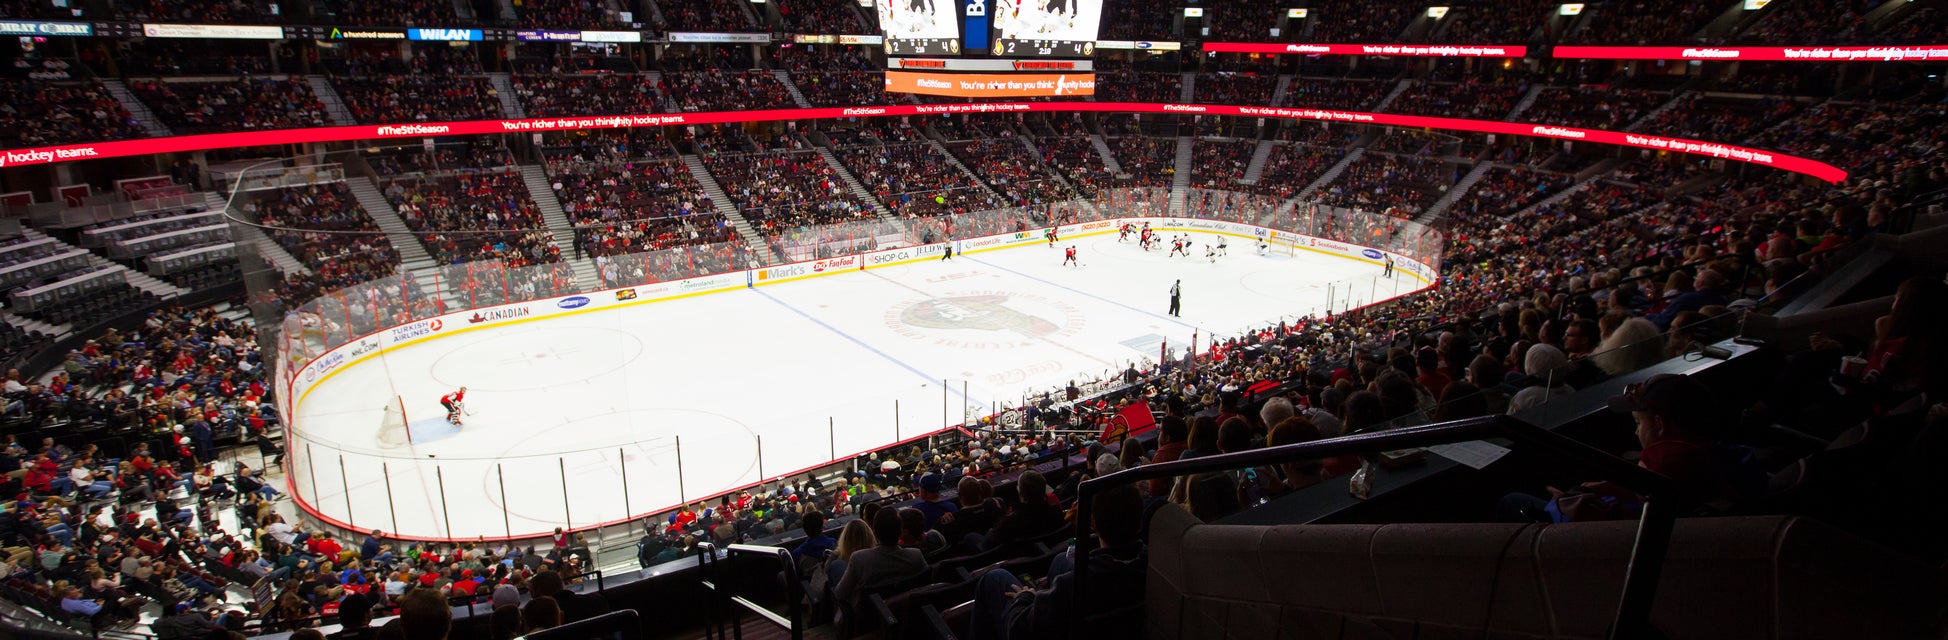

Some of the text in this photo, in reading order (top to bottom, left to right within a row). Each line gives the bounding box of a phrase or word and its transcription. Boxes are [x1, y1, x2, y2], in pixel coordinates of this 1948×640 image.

[0, 23, 36, 33] MBAT
[893, 42, 899, 52] 2
[942, 42, 948, 52] 4
[1008, 42, 1015, 52] 2
[1074, 44, 1081, 54] 4
[960, 81, 985, 90] You're
[987, 80, 1006, 90] richer
[1008, 81, 1022, 90] than
[1023, 82, 1036, 90] you
[1292, 110, 1304, 118] you
[1334, 112, 1354, 121] hockey
[502, 120, 530, 130] You're
[532, 120, 556, 128] richer
[557, 119, 577, 128] than
[579, 119, 594, 128] you
[634, 116, 660, 126] hockey
[378, 125, 449, 136] #The5thSeason
[7, 150, 54, 162] hockey
[56, 148, 98, 158] teams.
[1255, 228, 1266, 236] Bell
[1318, 241, 1349, 252] Scotiabank
[874, 252, 896, 264] SHOP
[768, 266, 805, 279] Mark's
[484, 307, 530, 322] CANADIAN
[392, 321, 428, 335] TURKISH
[394, 328, 430, 342] AIRLINES
